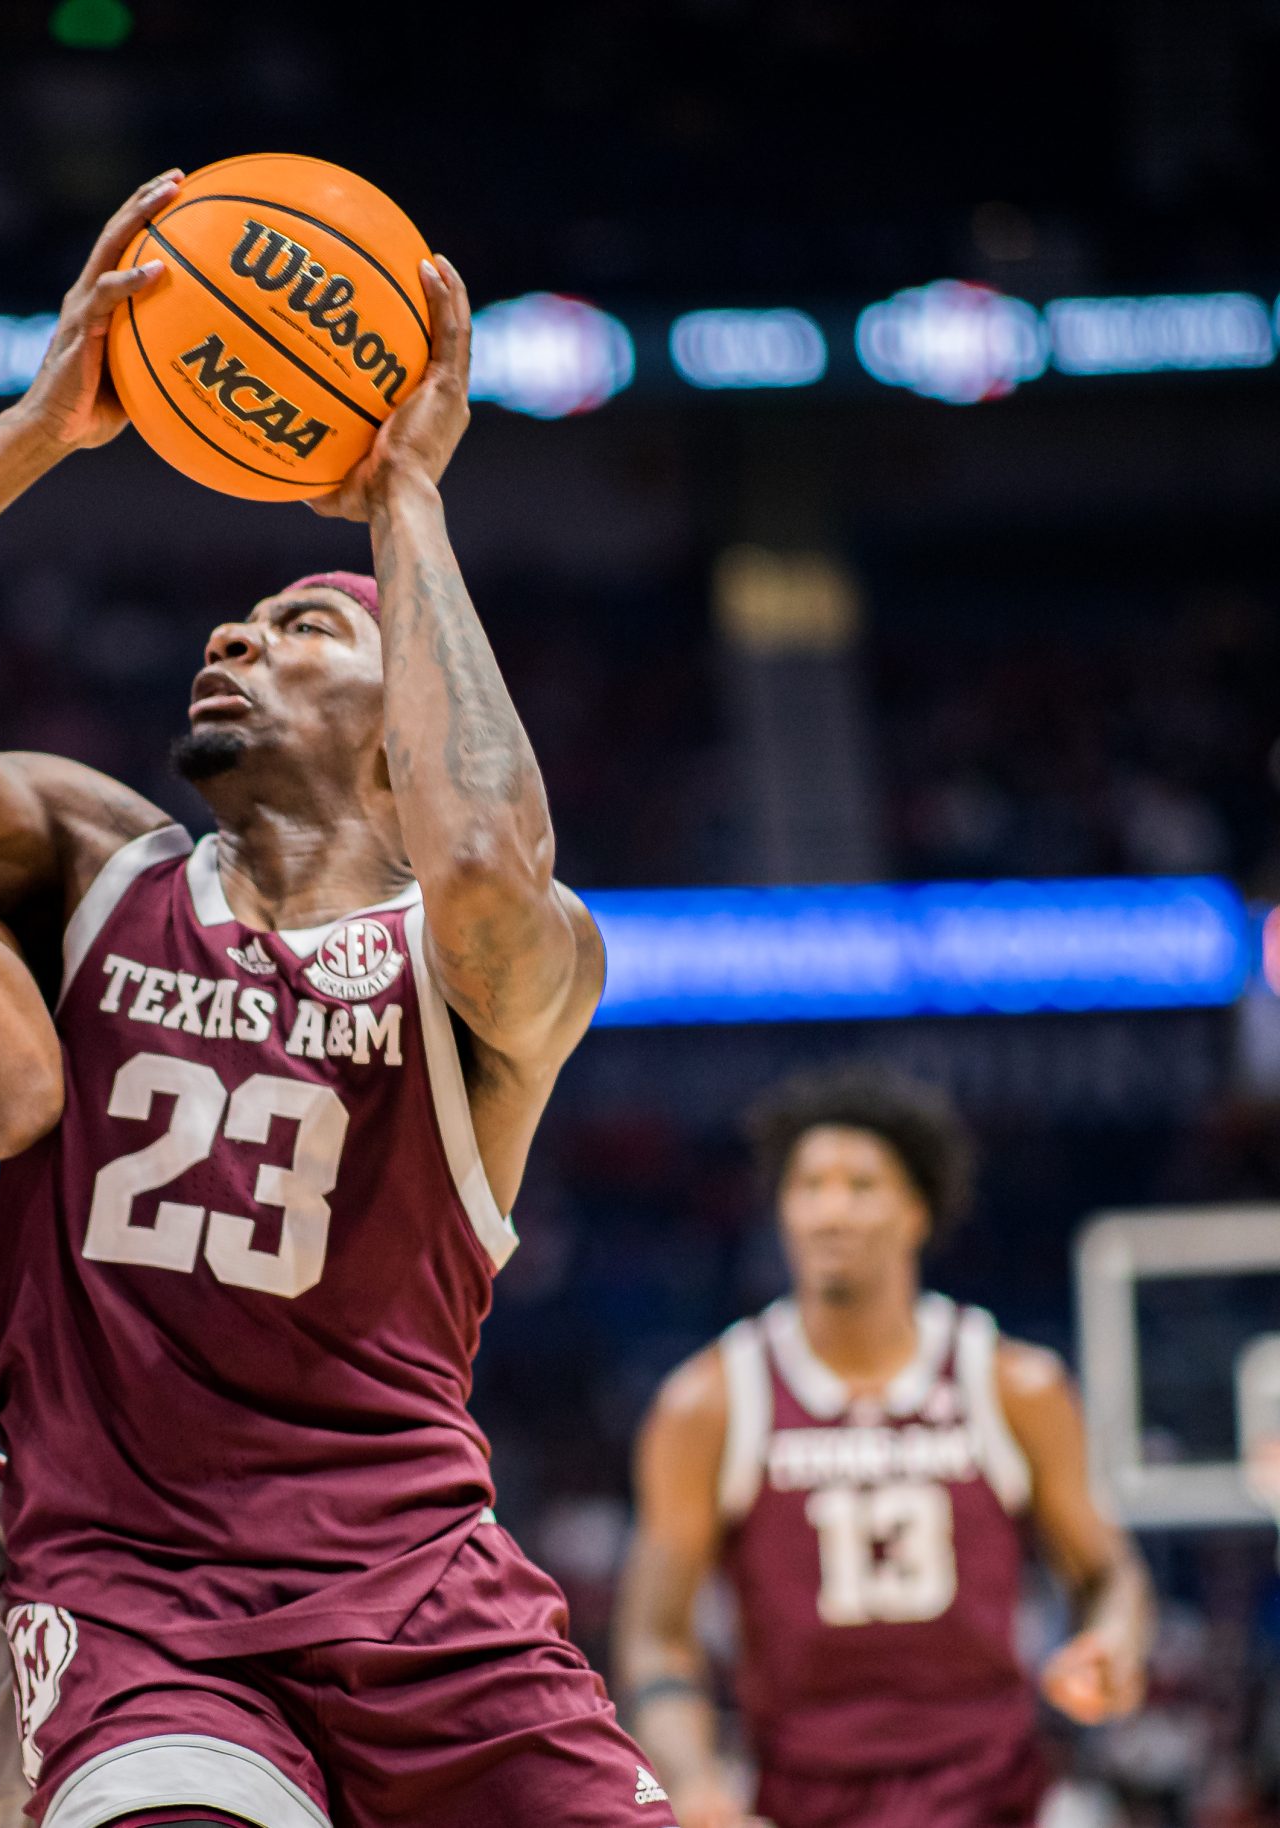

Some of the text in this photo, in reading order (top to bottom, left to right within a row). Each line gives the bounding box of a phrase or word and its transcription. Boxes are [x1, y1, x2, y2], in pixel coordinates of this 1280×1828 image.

[230, 217, 407, 407] Wilson
[180, 332, 331, 460] NCAA
[99, 953, 404, 1066] TEXAS A&M
[323, 921, 387, 979] SEC
[81, 1051, 351, 1300] 23
[804, 1480, 958, 1628] 13
